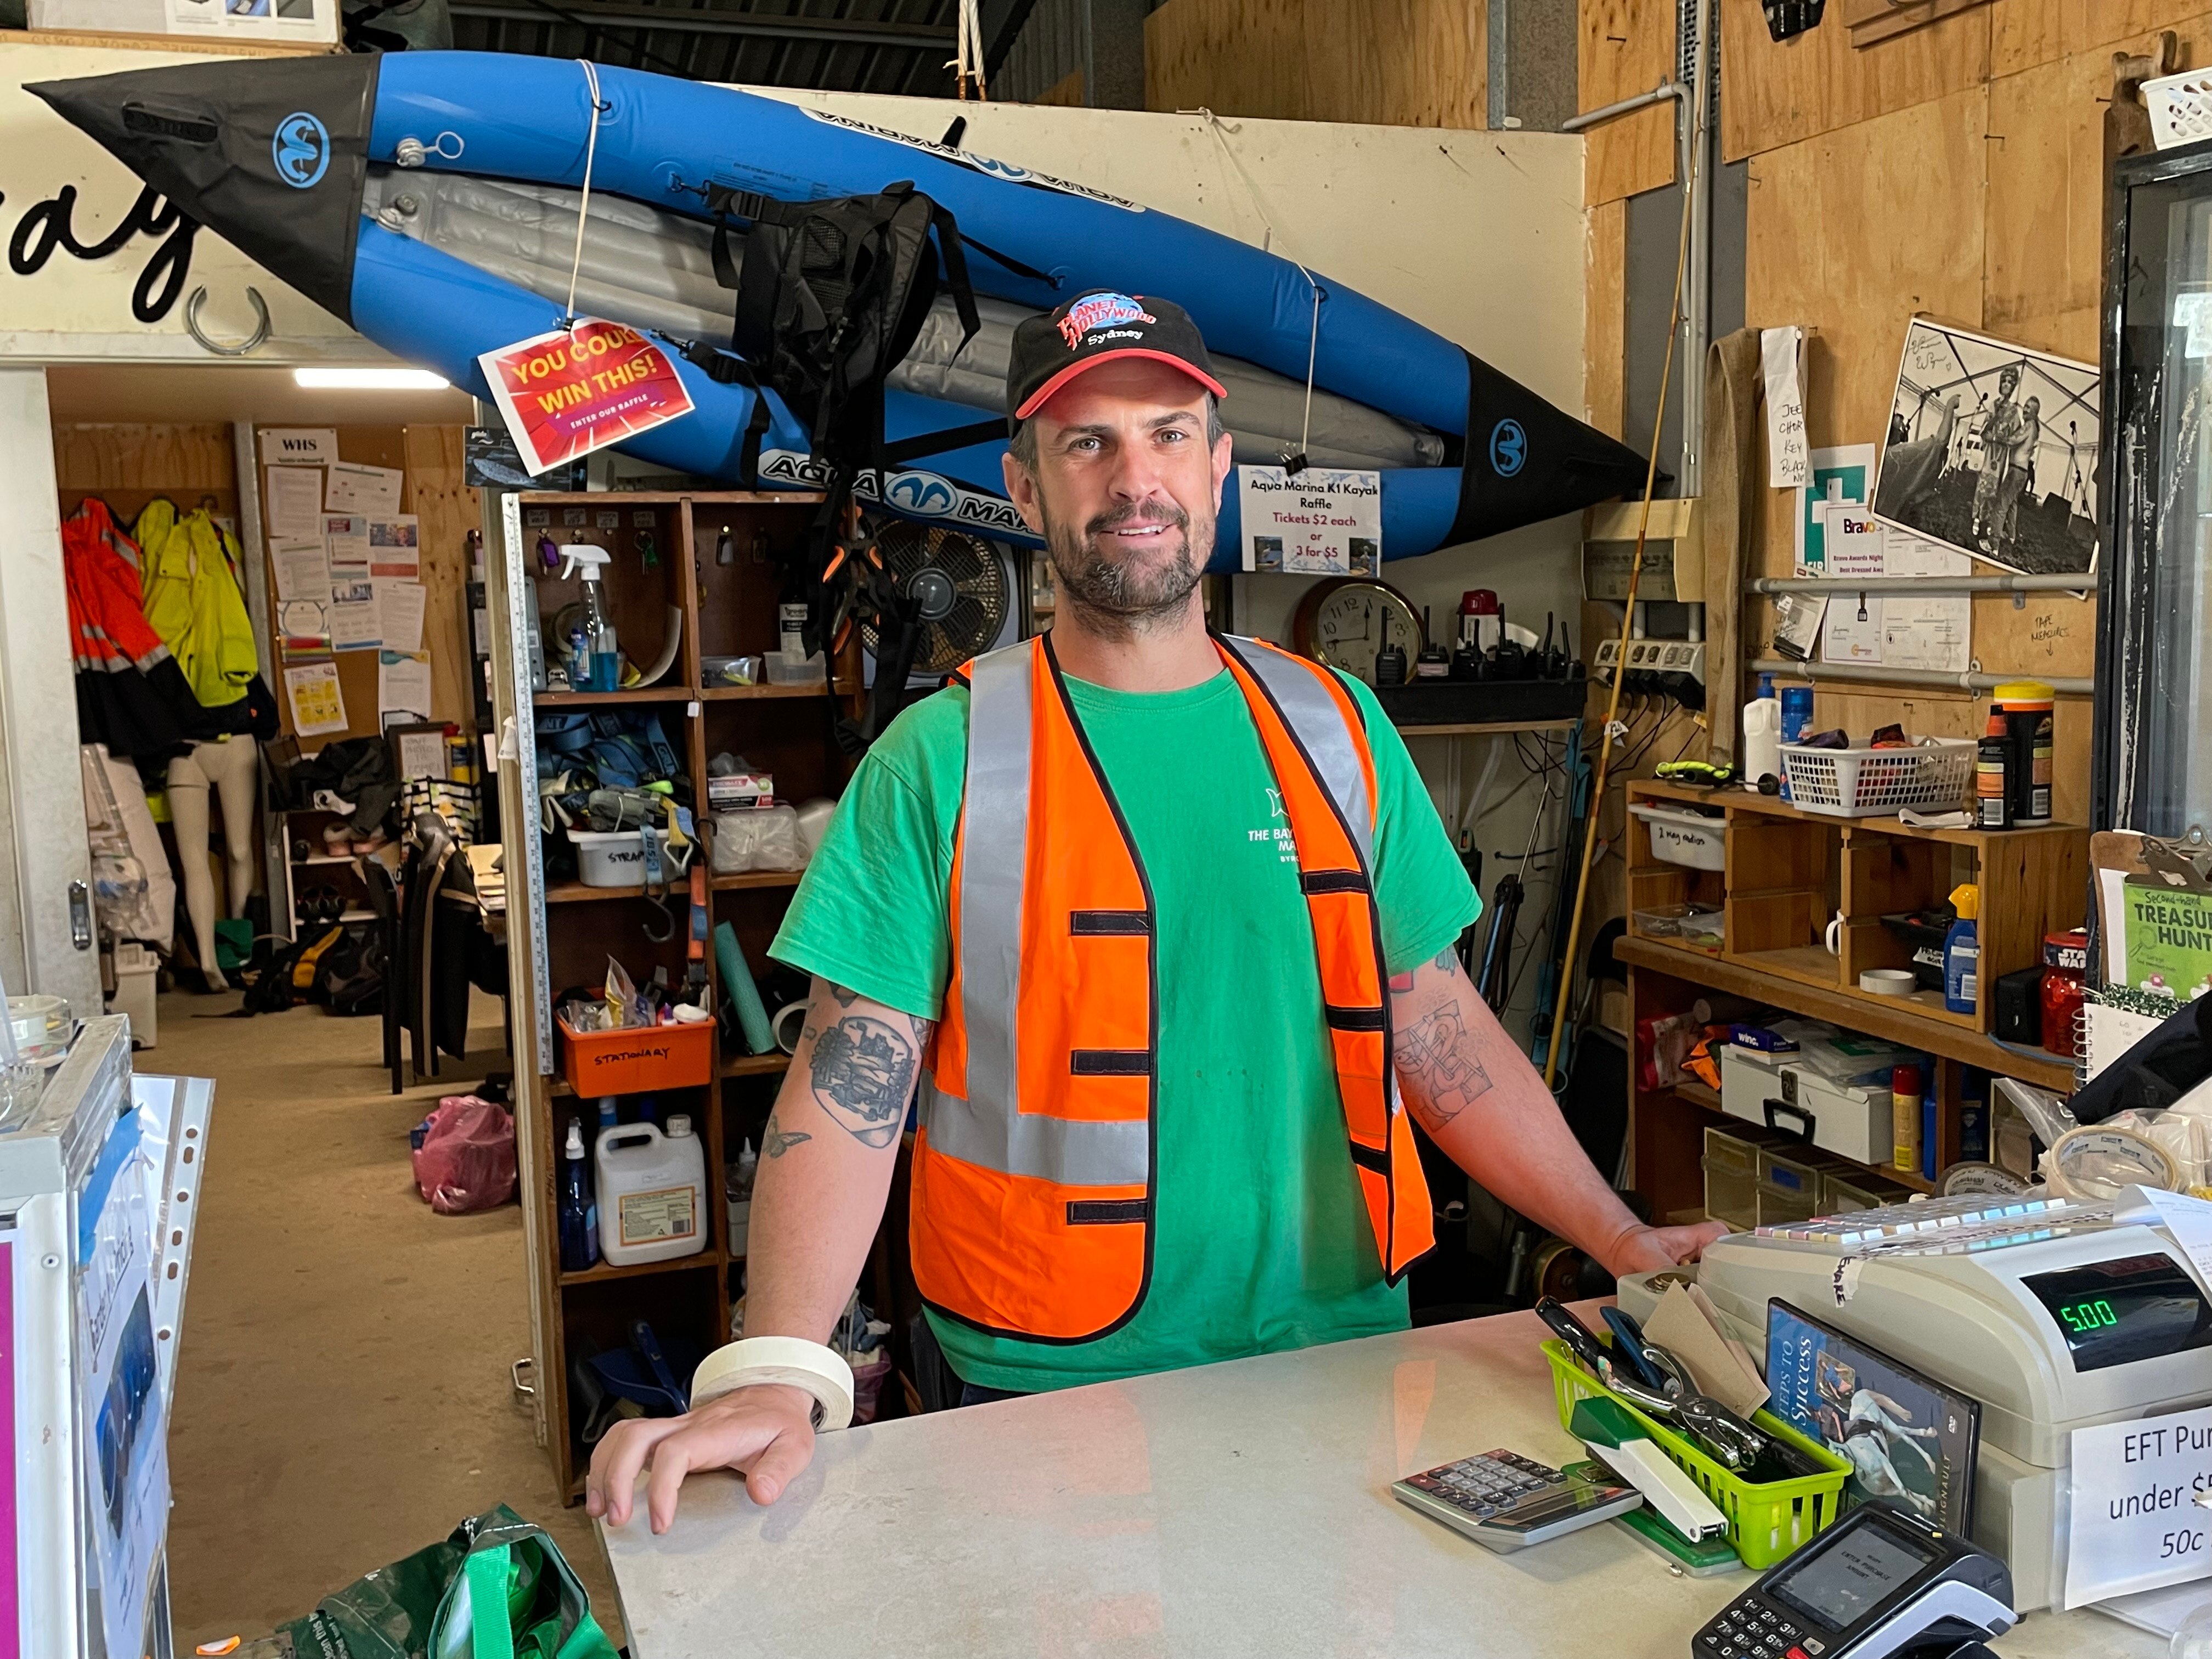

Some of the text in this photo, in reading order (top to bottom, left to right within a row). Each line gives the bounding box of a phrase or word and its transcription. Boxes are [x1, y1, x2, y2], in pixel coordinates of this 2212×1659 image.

[1057, 300, 1118, 340] PLANET
[1065, 307, 1157, 351] HOLLYWOOD
[1087, 329, 1144, 346] Sydney
[511, 349, 568, 385] YOU
[537, 354, 657, 415] WIN THIS!
[570, 393, 648, 430] ENTER OUR RAFFLE
[282, 439, 318, 451] WHS
[1784, 439, 1802, 455] KEY
[1251, 479, 1378, 498] Aqua Marina K1 Kayak
[1300, 498, 1332, 509] Raffle
[1273, 512, 1356, 527] Tickets $2 each
[1844, 518, 1875, 534] Bravo
[1296, 545, 1338, 558] 3 for $5
[1345, 597, 1359, 612] 12
[1323, 621, 1337, 635] 10
[1395, 623, 1406, 636] 3
[1248, 830, 1269, 842] THE
[2158, 926, 2212, 952] HUNT
[594, 1046, 671, 1066] STATIONARY
[2061, 1300, 2118, 1333] 5.00
[1779, 1340, 1793, 1420] TEPS TO
[1791, 1336, 1812, 1426] Success
[2124, 1429, 2166, 1463] EFT
[2109, 1483, 2184, 1520] under
[2160, 1528, 2204, 1559] 50c
[1861, 1562, 1892, 1581] PURCHASE
[1745, 1599, 1753, 1607] 1
[1731, 1610, 1741, 1618] 4
[1760, 1611, 1771, 1620] 2
[1717, 1620, 1728, 1629] 7
[1747, 1621, 1759, 1630] 5
[1780, 1623, 1791, 1633] 3
[1734, 1633, 1745, 1643] 8
[1766, 1634, 1776, 1644] 6
[1721, 1646, 1733, 1656] 0
[1752, 1646, 1763, 1655] 9
